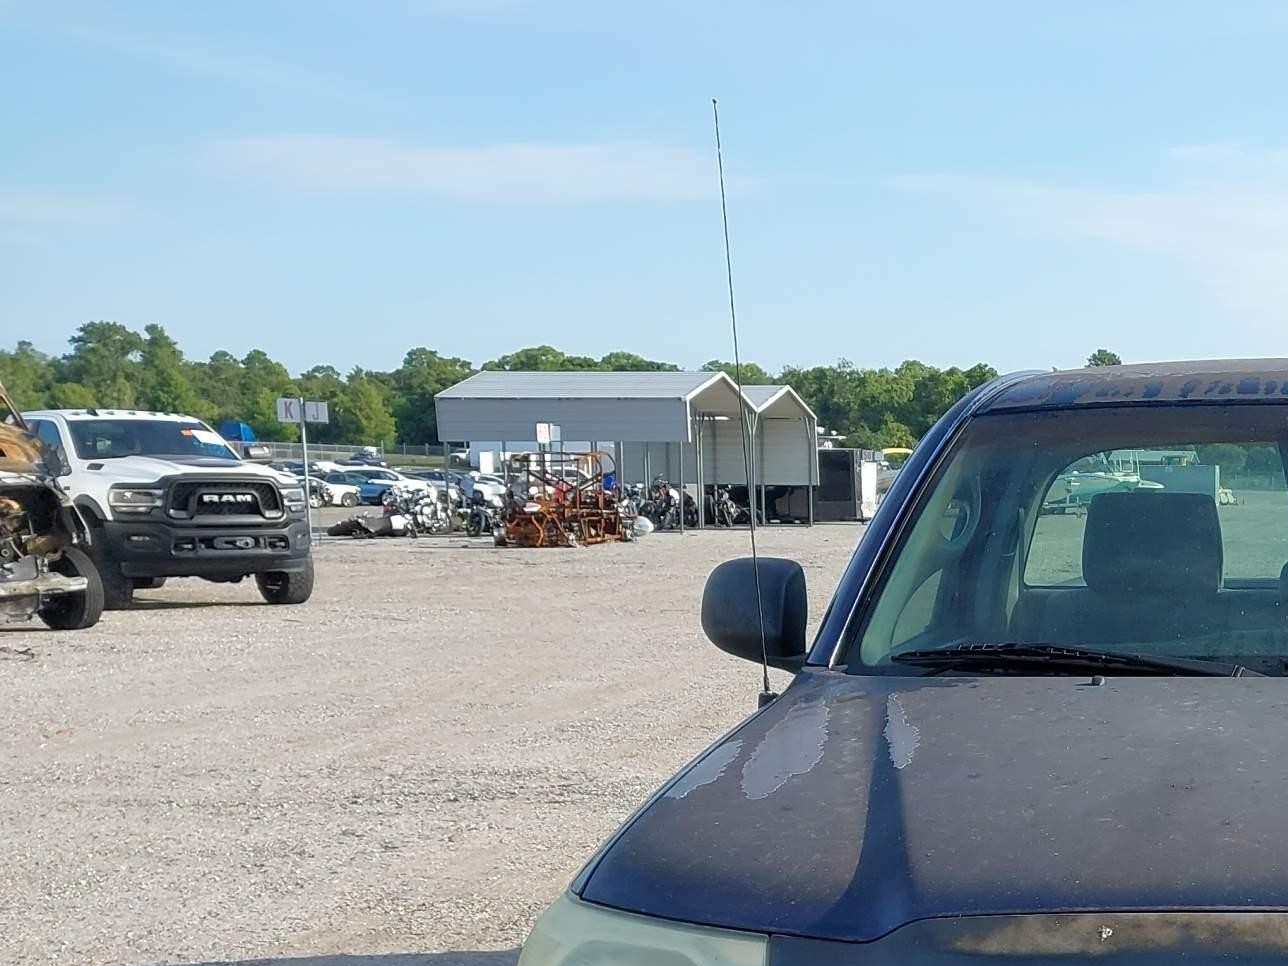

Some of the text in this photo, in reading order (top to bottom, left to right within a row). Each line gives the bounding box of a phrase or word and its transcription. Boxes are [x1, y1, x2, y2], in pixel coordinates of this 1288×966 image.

[284, 400, 294, 419] K
[312, 401, 320, 420] J
[202, 494, 253, 503] RAM
